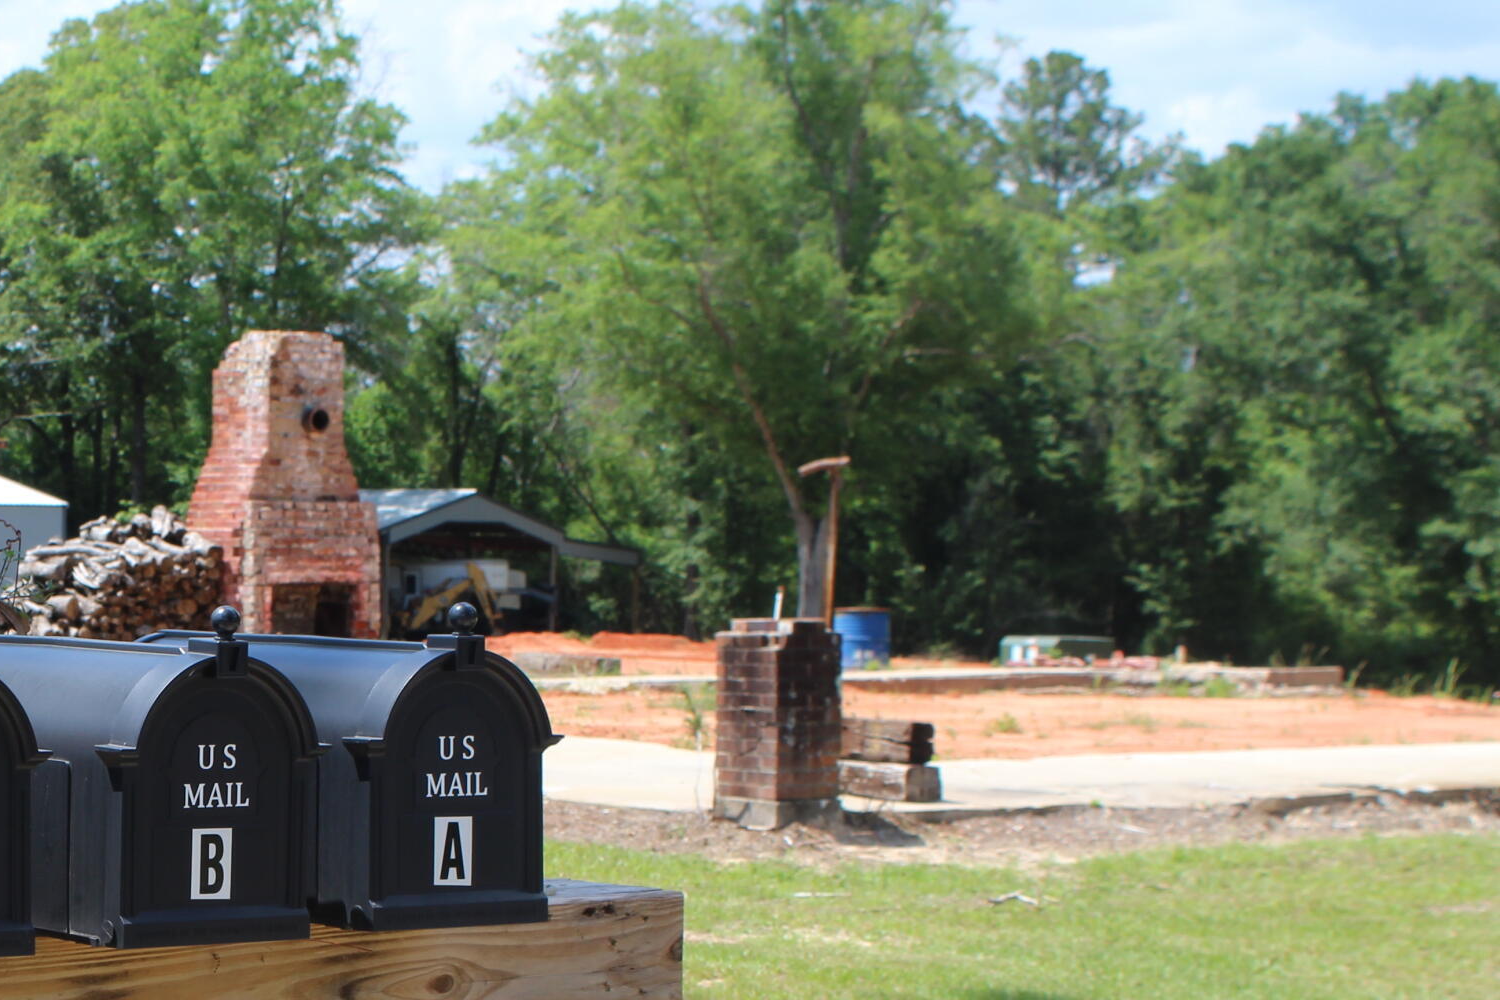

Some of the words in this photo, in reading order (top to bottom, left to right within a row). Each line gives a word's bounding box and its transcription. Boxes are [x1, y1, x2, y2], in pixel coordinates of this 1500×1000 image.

[183, 781, 250, 809] MAIL
[425, 771, 488, 798] MAIL
[199, 833, 225, 895] B
[439, 821, 466, 881] A
